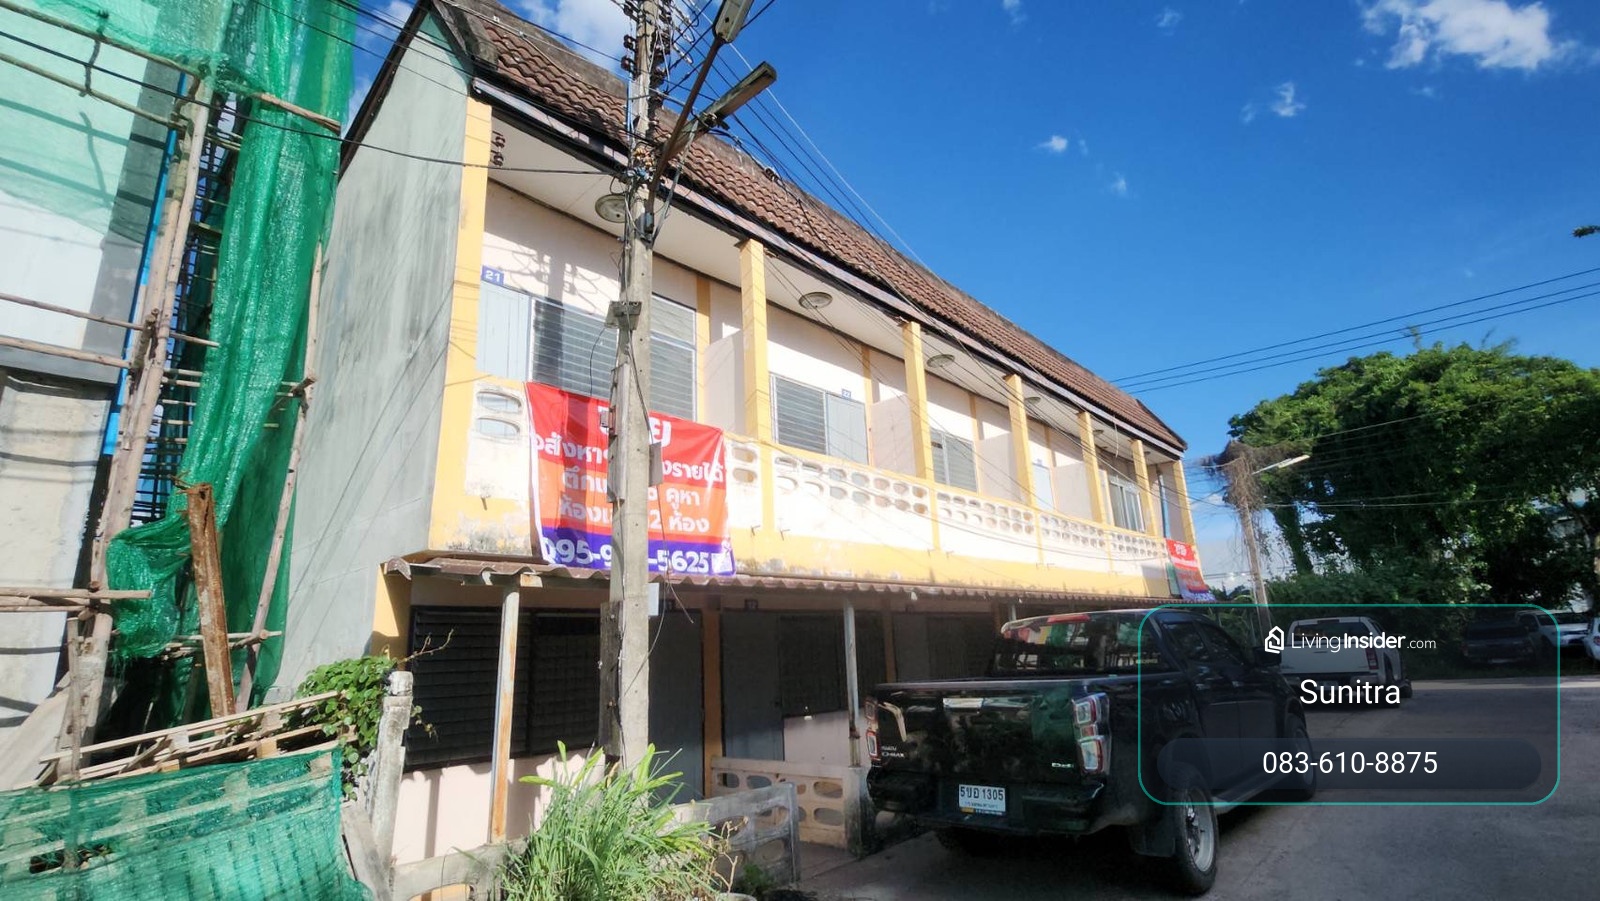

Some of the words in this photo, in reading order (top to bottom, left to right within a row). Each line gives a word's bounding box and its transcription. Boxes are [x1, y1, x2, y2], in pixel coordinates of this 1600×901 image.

[485, 269, 501, 283] 21
[668, 510, 710, 533] ห้อง
[541, 537, 710, 574] 095-9-5625
[982, 789, 1004, 801] 1305
